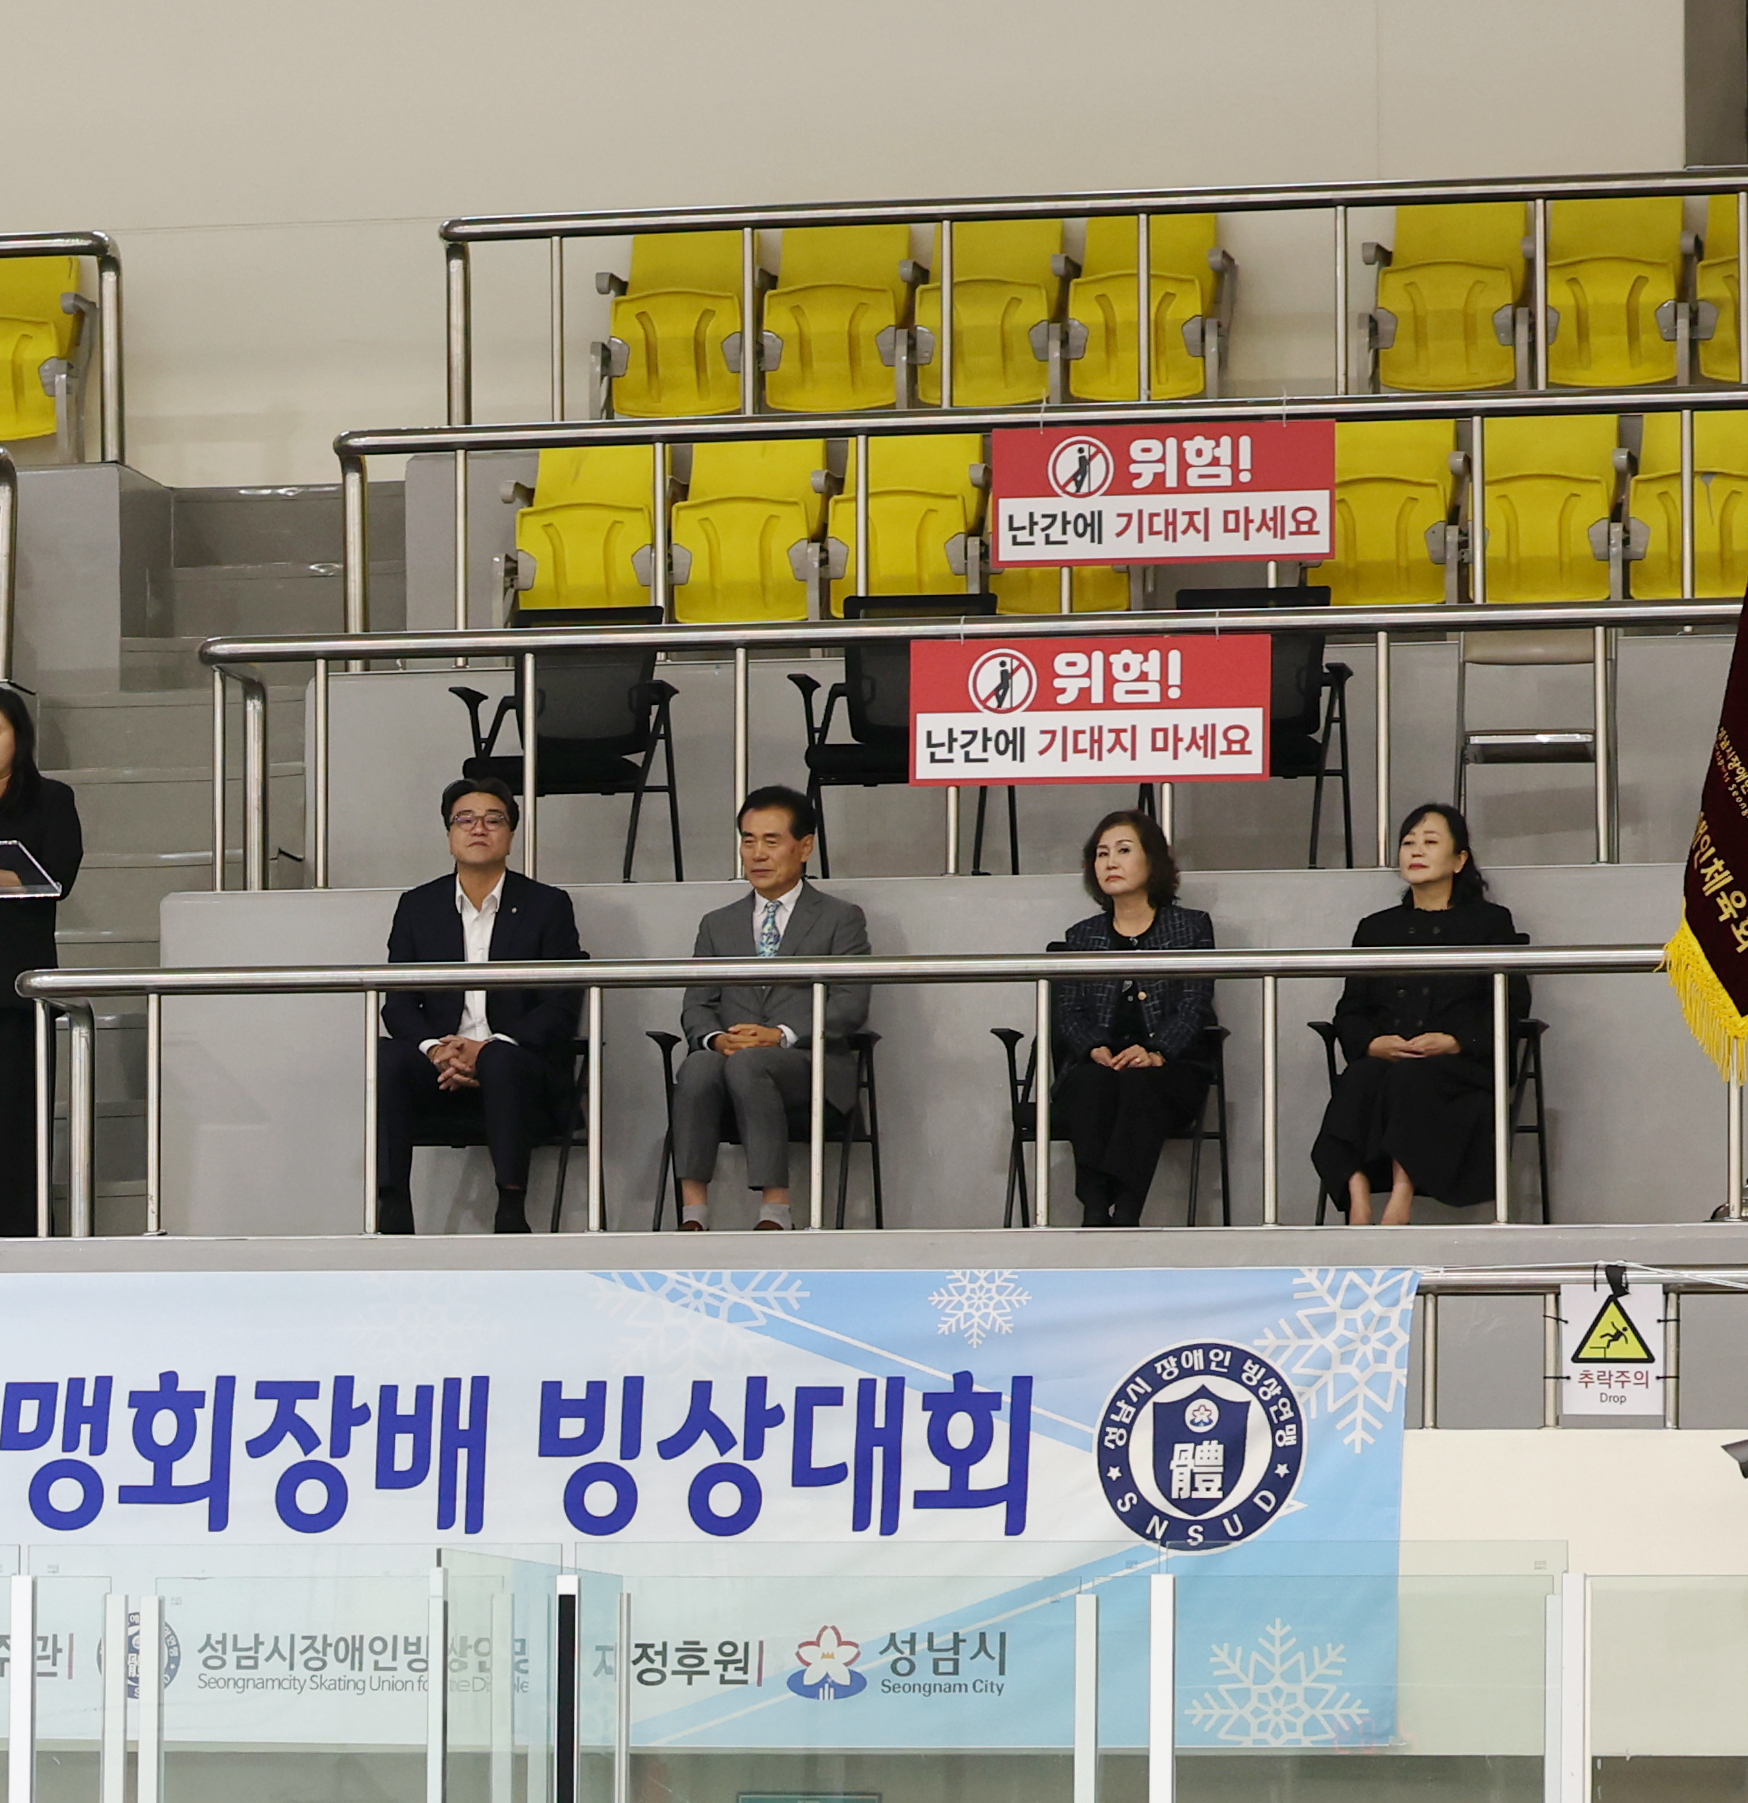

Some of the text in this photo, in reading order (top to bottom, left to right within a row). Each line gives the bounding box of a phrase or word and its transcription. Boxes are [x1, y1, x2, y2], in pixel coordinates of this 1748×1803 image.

[1129, 434, 1253, 490] 위험!
[1007, 505, 1320, 546] 난간에 기대지 마세요
[1052, 648, 1183, 705] 위험!
[925, 723, 1253, 764] 난간에 기대지 마세요
[1103, 1348, 1299, 1450] 성남시 장애인 빙상연맹
[1577, 1369, 1651, 1390] 추락주의
[1599, 1392, 1627, 1405] Drop
[538, 1370, 1034, 1537] 빙상대회
[878, 1631, 1007, 1677] 성남시
[197, 1673, 307, 1695] Seongnamcity
[309, 1674, 367, 1695] Skating
[369, 1675, 410, 1692] Union
[880, 1678, 1005, 1697] Seongnam City
